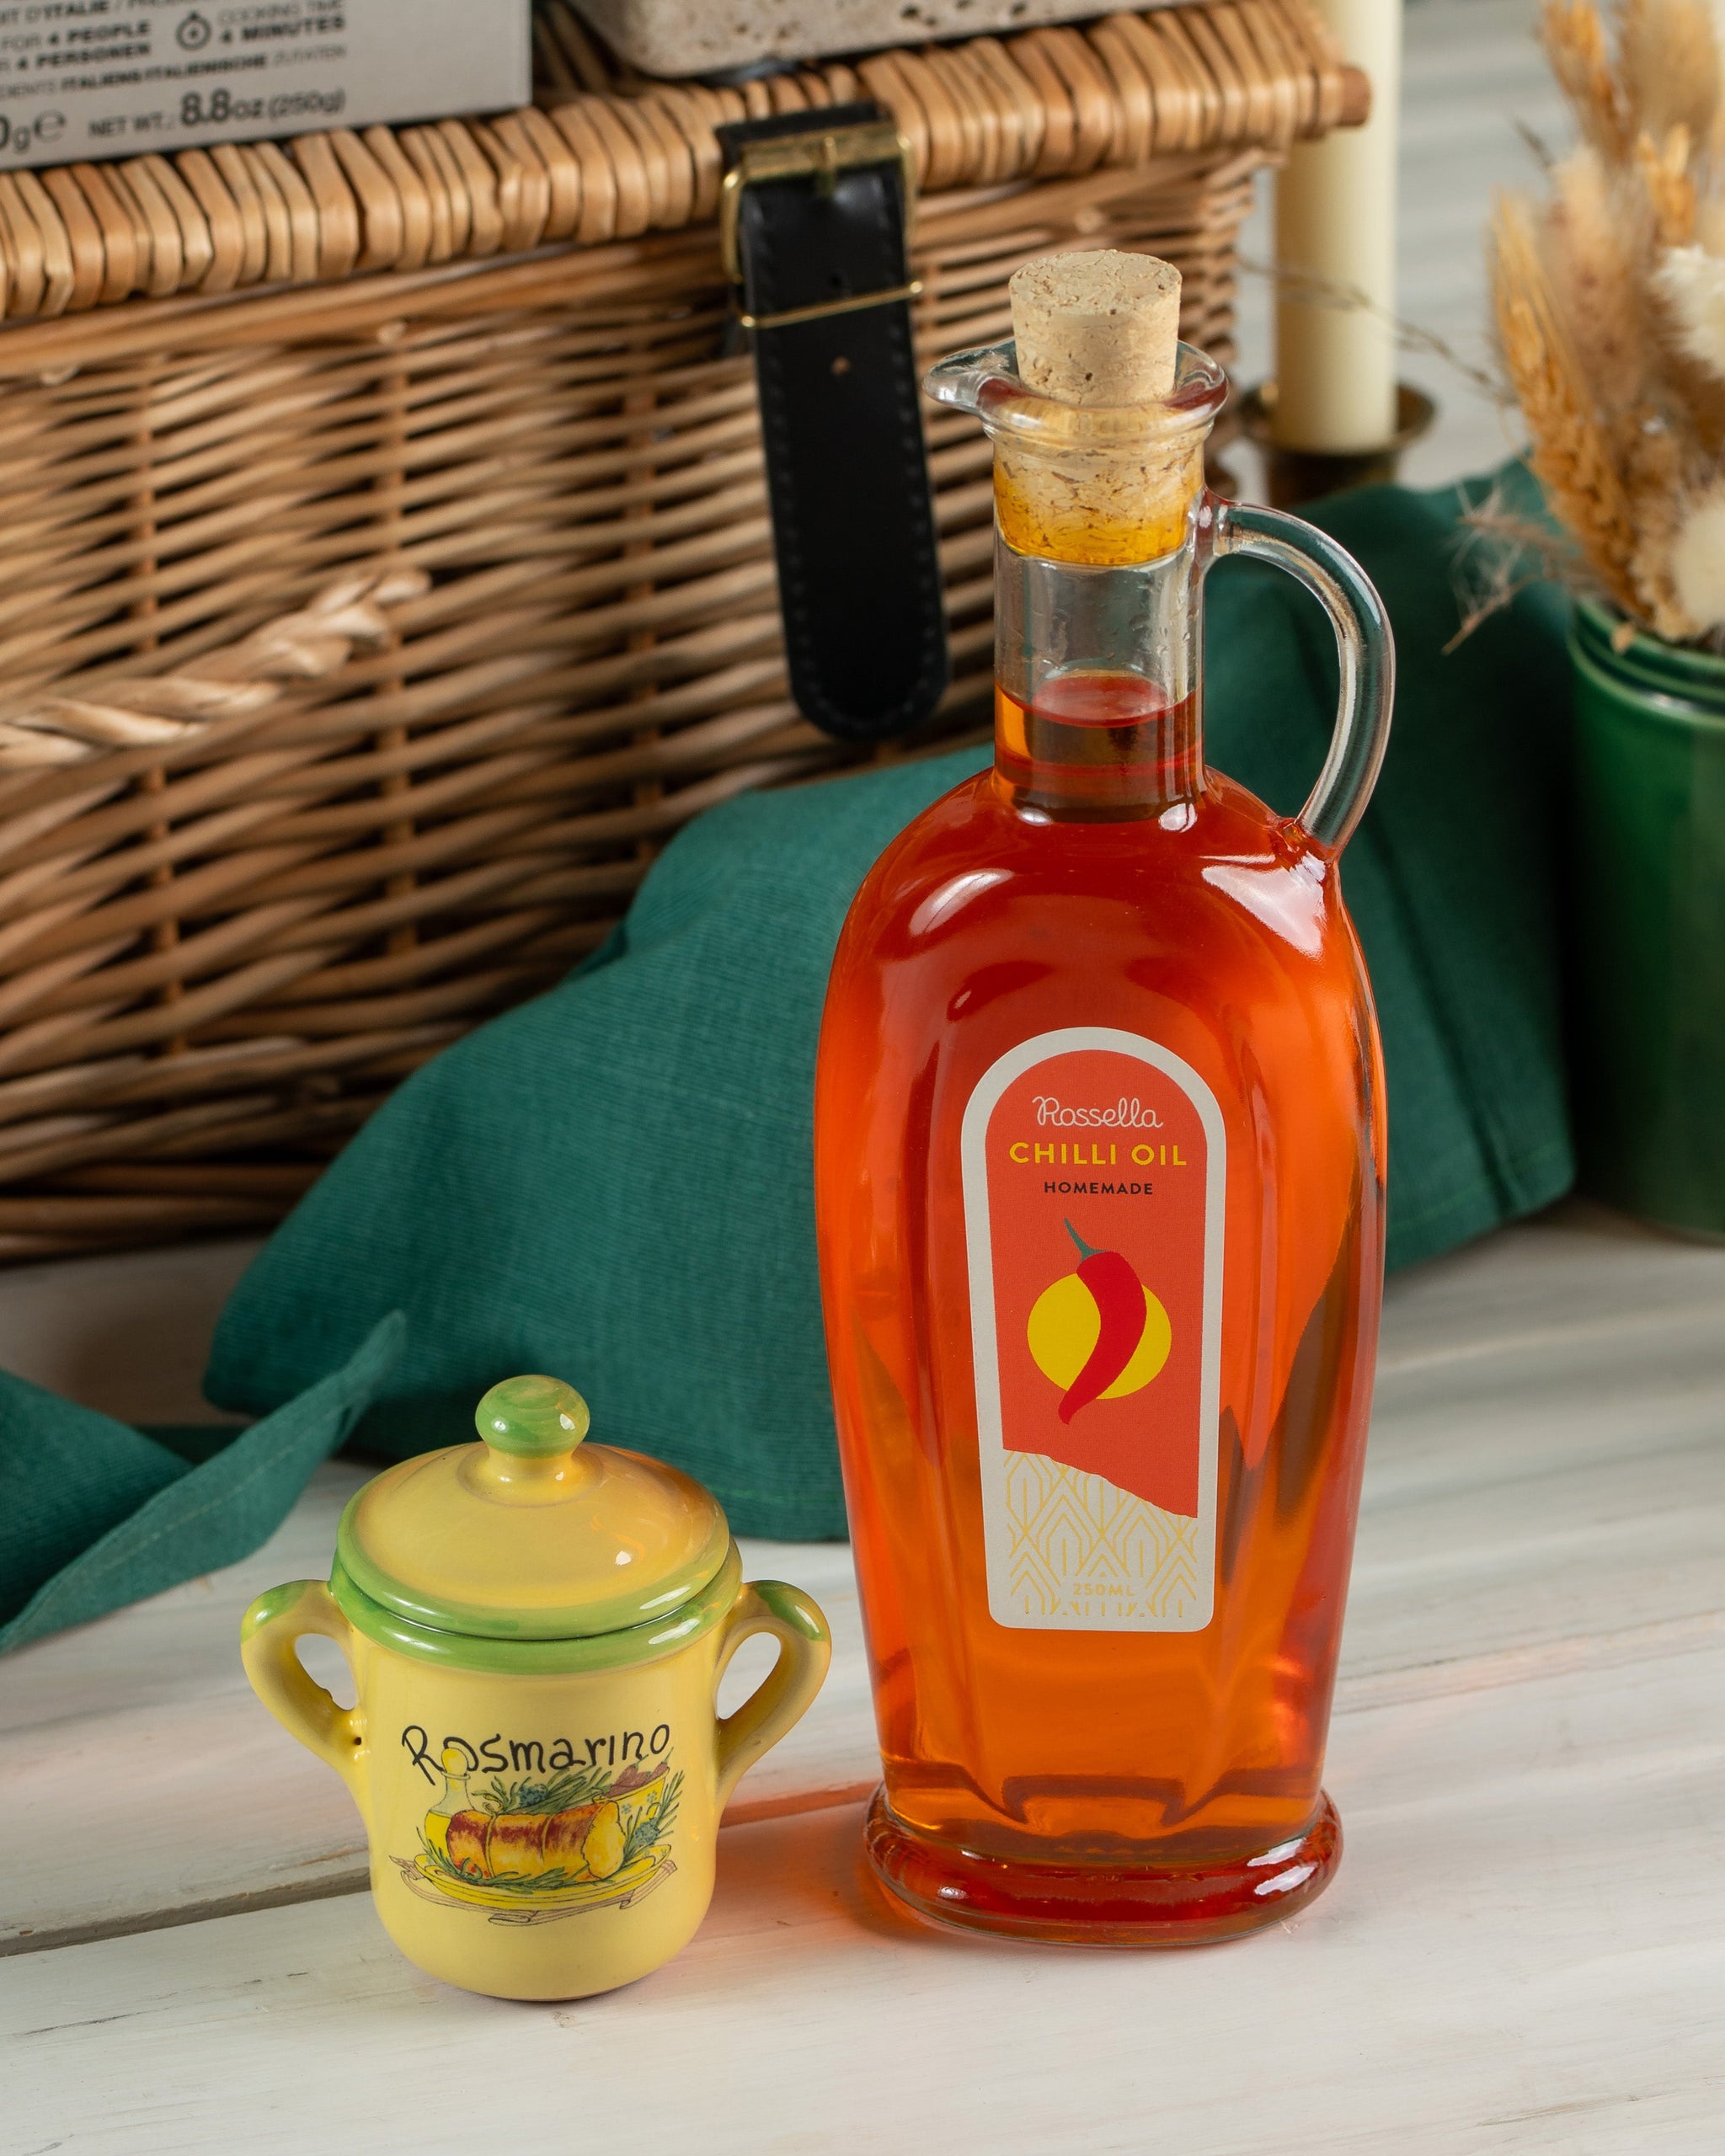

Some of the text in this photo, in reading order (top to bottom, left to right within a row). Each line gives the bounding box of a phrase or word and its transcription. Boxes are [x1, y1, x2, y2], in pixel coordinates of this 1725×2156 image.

[49, 30, 60, 45] 4
[67, 19, 151, 42] PEOPLE
[242, 13, 345, 40] MINUTES
[35, 41, 152, 68] PERSONEN
[88, 115, 127, 139] NET
[268, 88, 347, 123] (250g)
[1032, 1096, 1164, 1129] Rossella
[1010, 1142, 1187, 1166] CHILLI OIL
[1044, 1182, 1153, 1195] HOMEMADE
[1073, 1582, 1135, 1597] 250ML
[401, 1723, 670, 1786] Rosmarino
